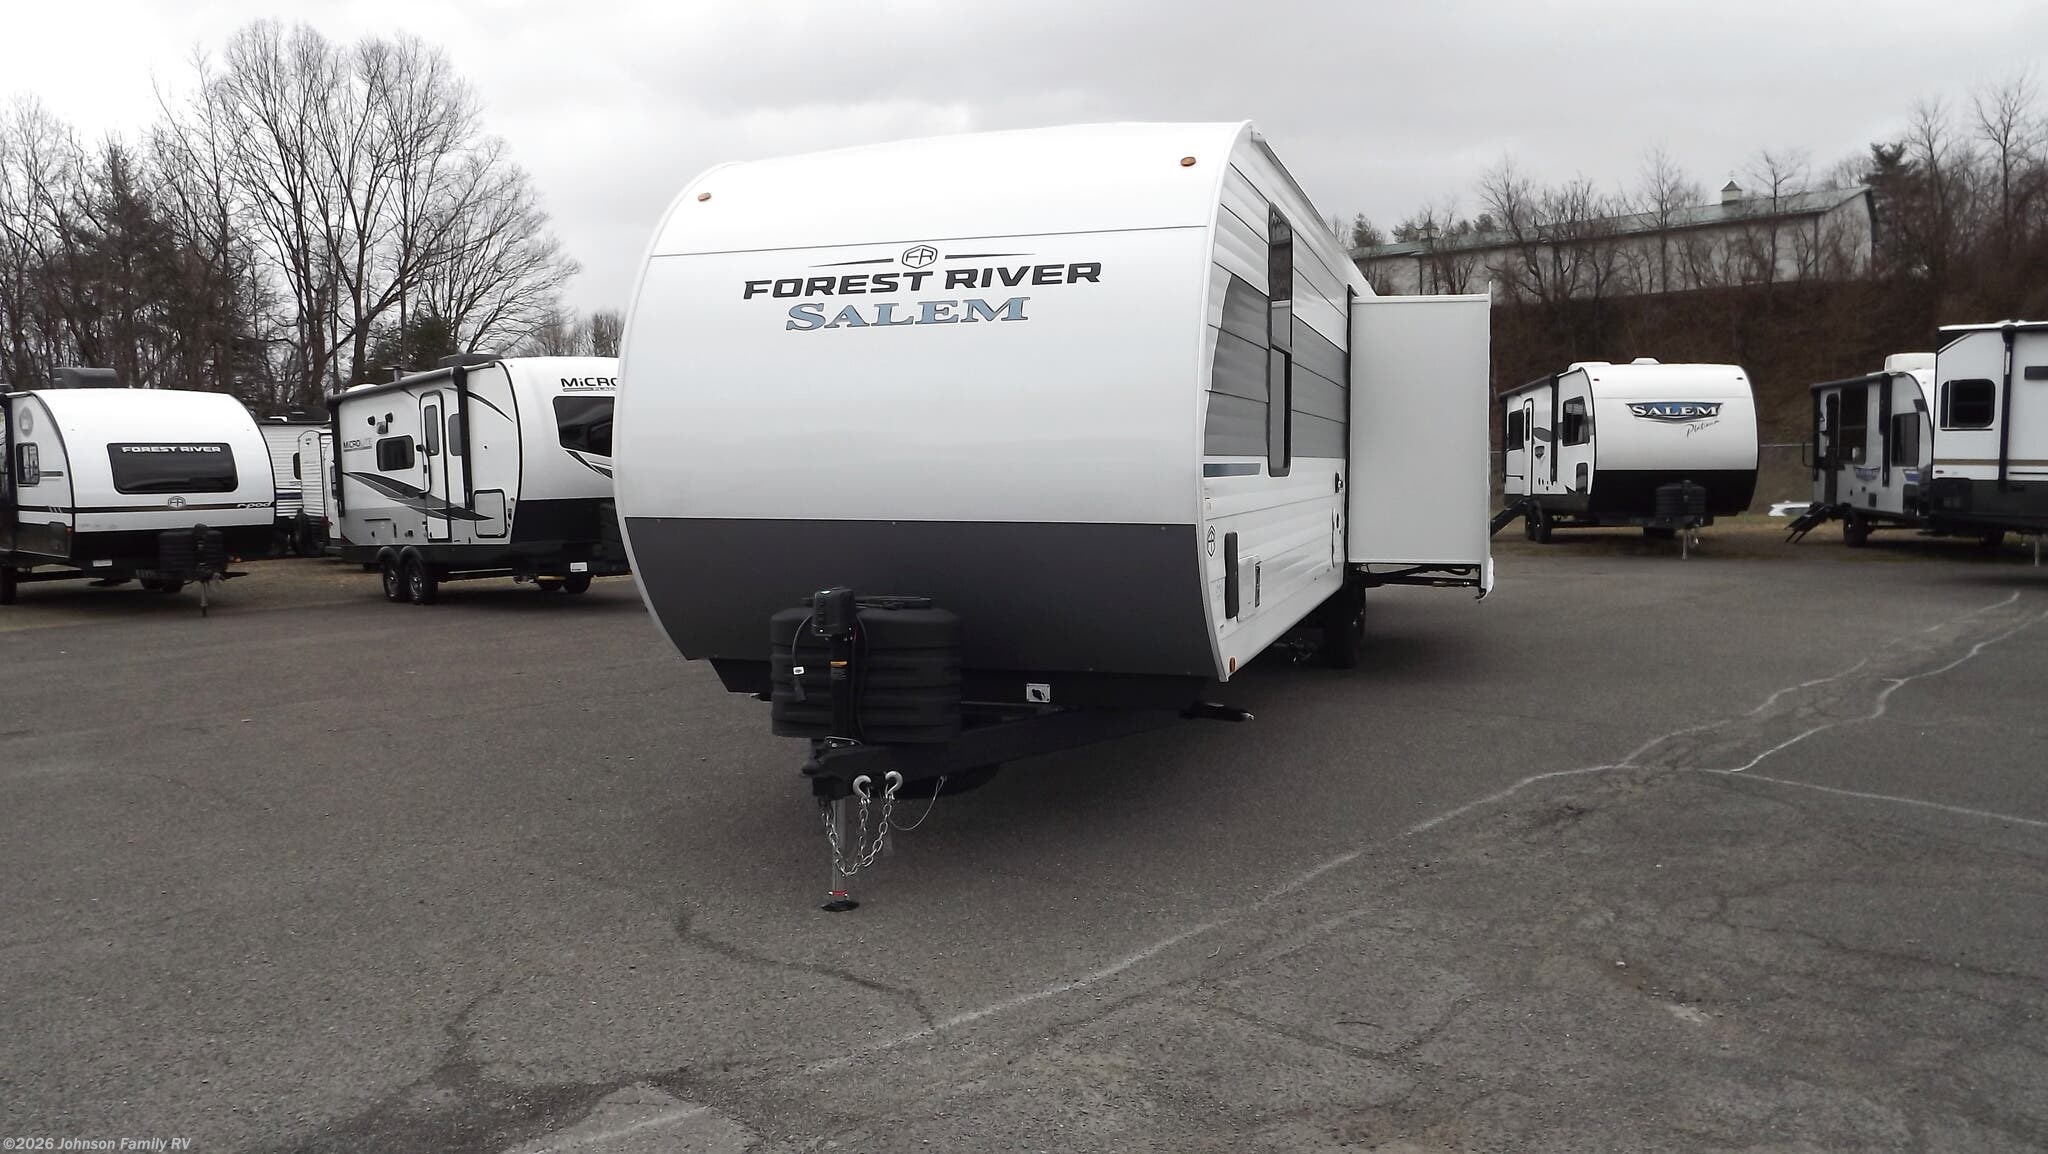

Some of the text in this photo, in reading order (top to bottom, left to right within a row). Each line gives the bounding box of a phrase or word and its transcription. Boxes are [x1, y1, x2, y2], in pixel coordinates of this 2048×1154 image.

[743, 262, 1102, 300] FOREST RIVER
[786, 297, 1031, 331] SALEM
[1632, 405, 1718, 416] SALEM
